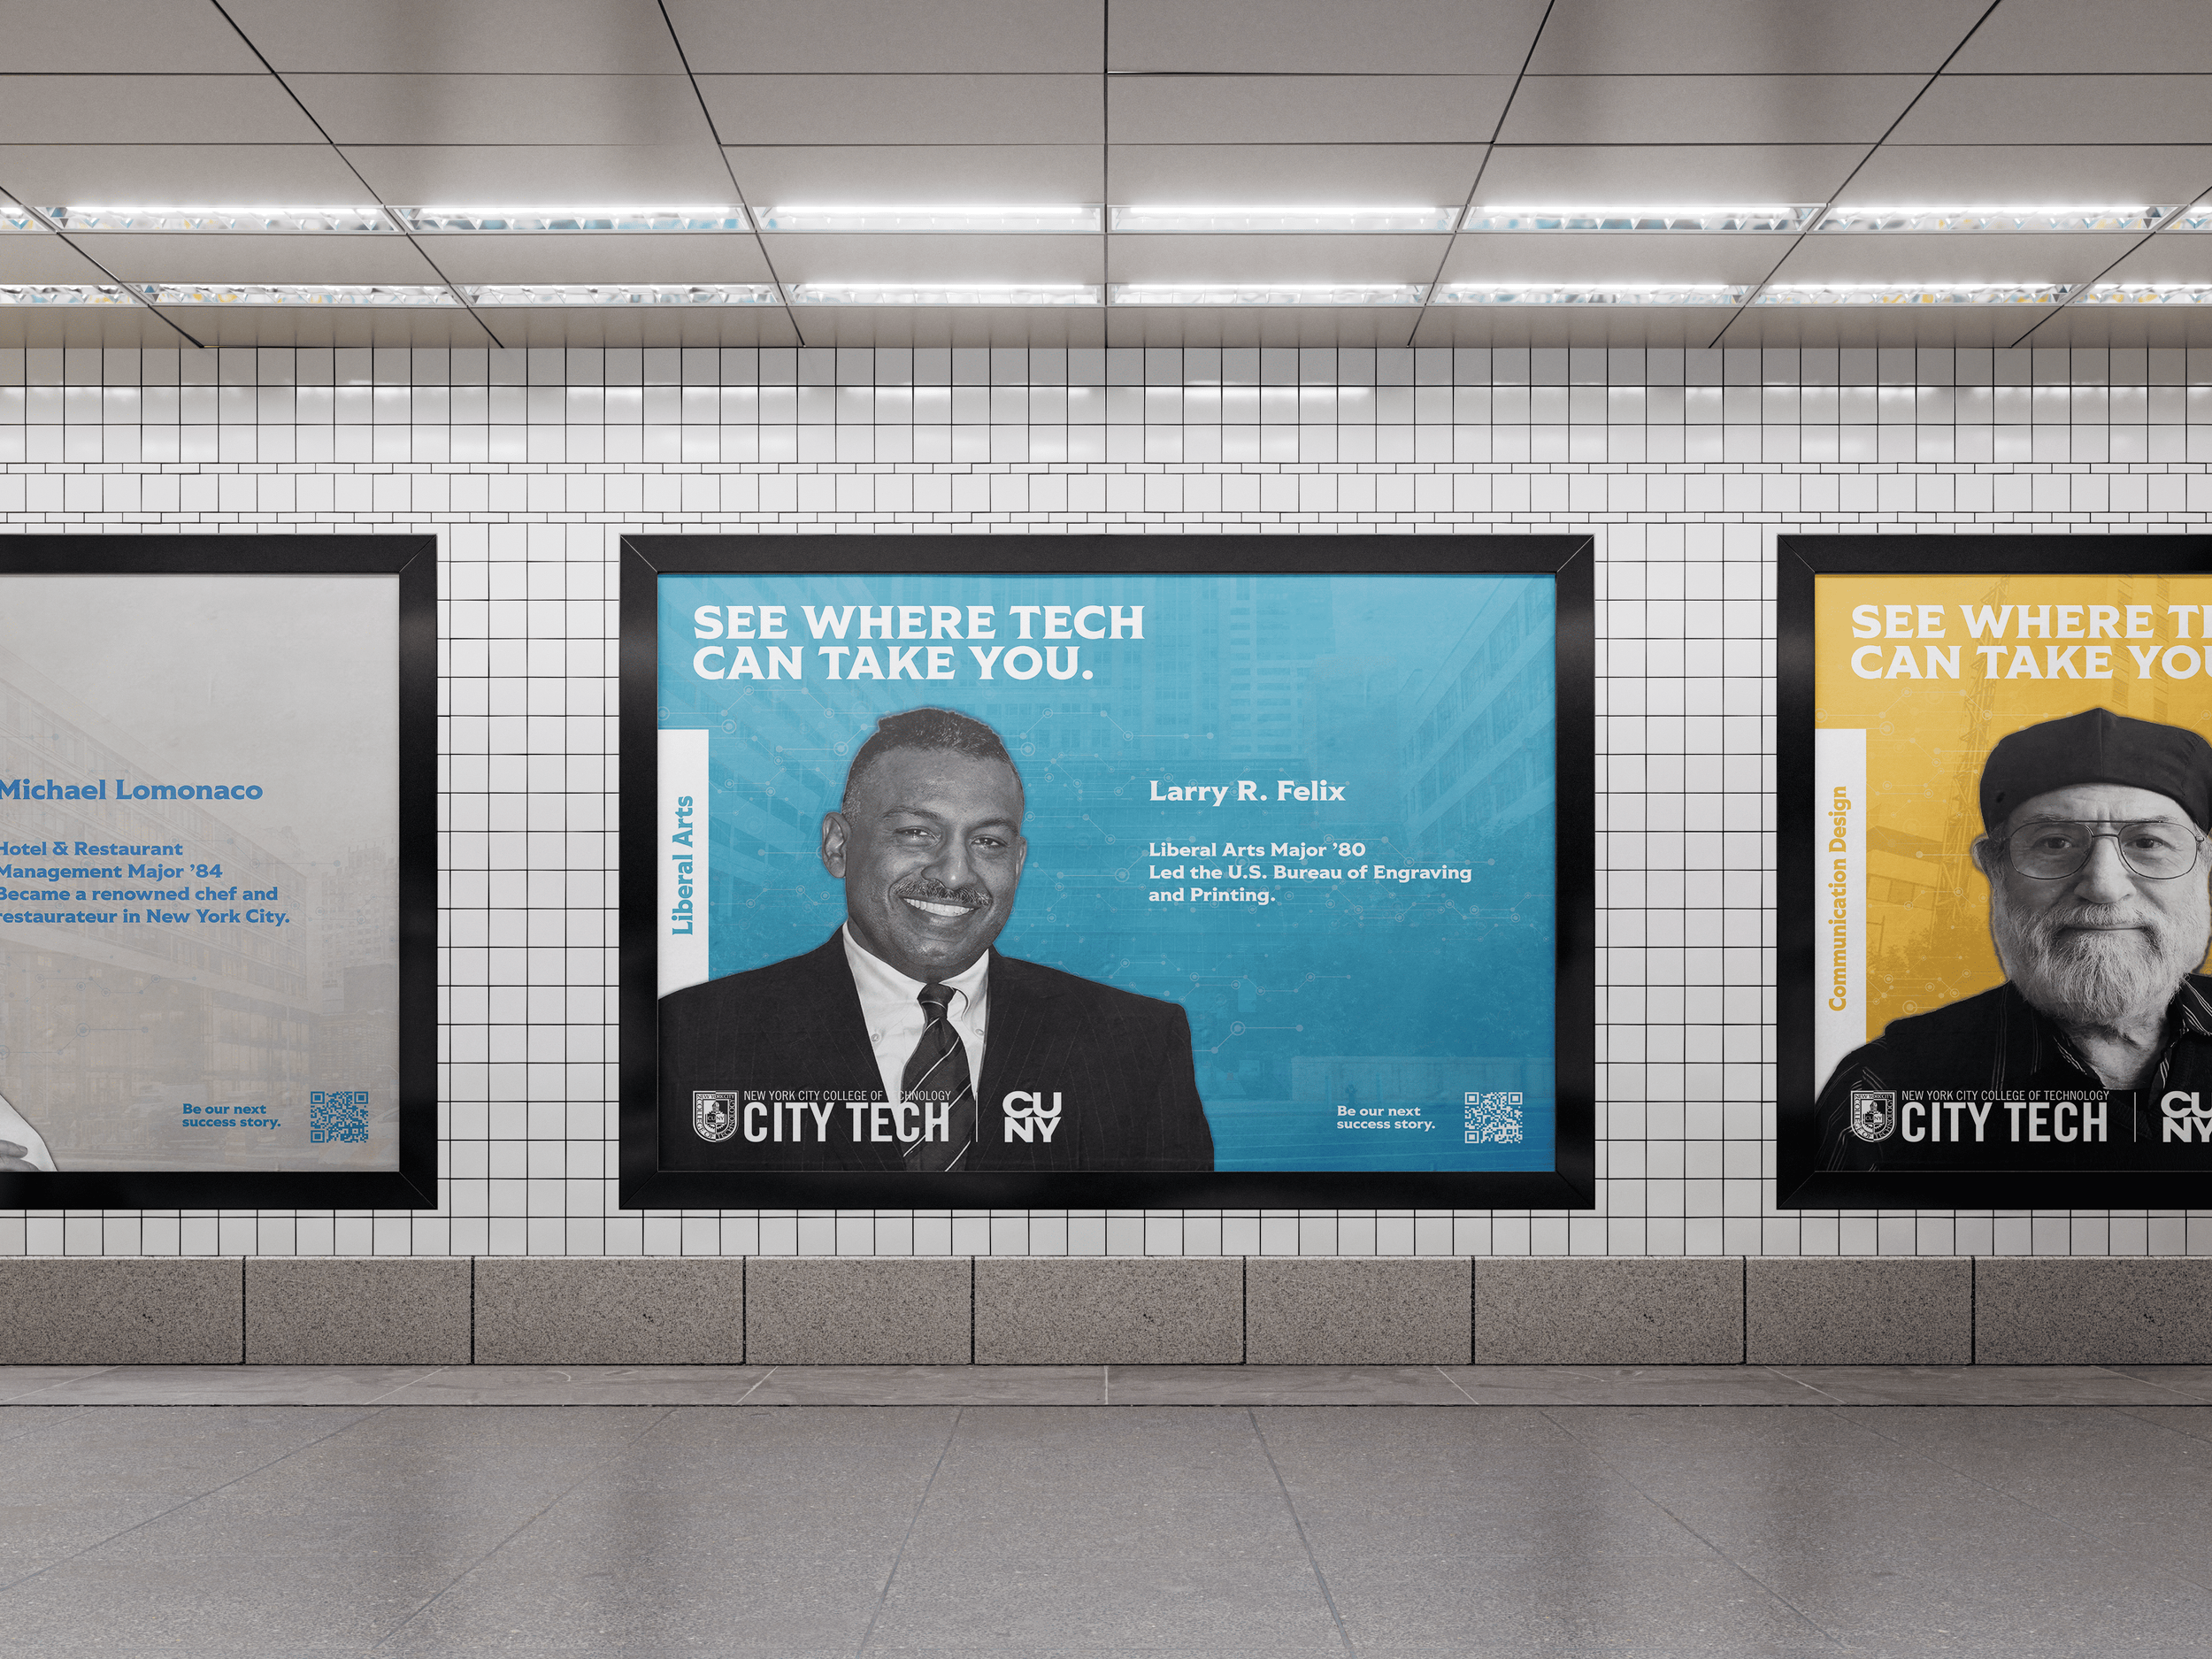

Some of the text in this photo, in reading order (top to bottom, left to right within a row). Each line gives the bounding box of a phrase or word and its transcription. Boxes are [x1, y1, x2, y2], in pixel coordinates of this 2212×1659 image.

[695, 605, 1144, 639] SEE WHERE TECH
[1851, 604, 1946, 639] SEE
[1958, 605, 2154, 638] WHERE
[694, 645, 1094, 680] CAN TAKE YOU.
[1851, 645, 1962, 680] CAN
[1976, 646, 2113, 679] TAKE
[0, 778, 263, 800] Michael Lomonaco
[1150, 780, 1346, 807] Larry R. Felix
[0, 841, 183, 856] Hotel & Restaurant
[1149, 842, 1216, 856] Liberal
[1222, 842, 1265, 856] Arts
[1271, 842, 1326, 860] Major
[0, 864, 122, 881] Management
[128, 864, 184, 881] Major
[672, 795, 693, 935] Liberal Arts
[1149, 864, 1471, 883] Led the U.S. Bureau of Engraving
[0, 887, 278, 901] Became a renowned chef and
[1149, 887, 1276, 905] and Printing.
[1828, 786, 1851, 1011] Communication Design
[123, 909, 141, 923] in
[147, 909, 191, 923] New
[196, 909, 242, 923] York
[246, 909, 290, 926] City.
[744, 1090, 765, 1101] NEW
[769, 1090, 795, 1101] YORK
[798, 1090, 820, 1101] CITY
[823, 1090, 867, 1101] COLLEGE
[871, 1090, 883, 1101] OF
[1902, 1090, 2109, 1101] NEW YORK CITY COLLEGE OF TECHNOLOGY
[183, 1103, 266, 1115] Be our next
[1338, 1106, 1356, 1117] Be
[1388, 1108, 1421, 1117] next
[182, 1118, 281, 1130] success story.
[744, 1102, 949, 1142] CITY TECH
[1337, 1120, 1436, 1132] success story.
[1902, 1102, 2108, 1142] CITY TECH
